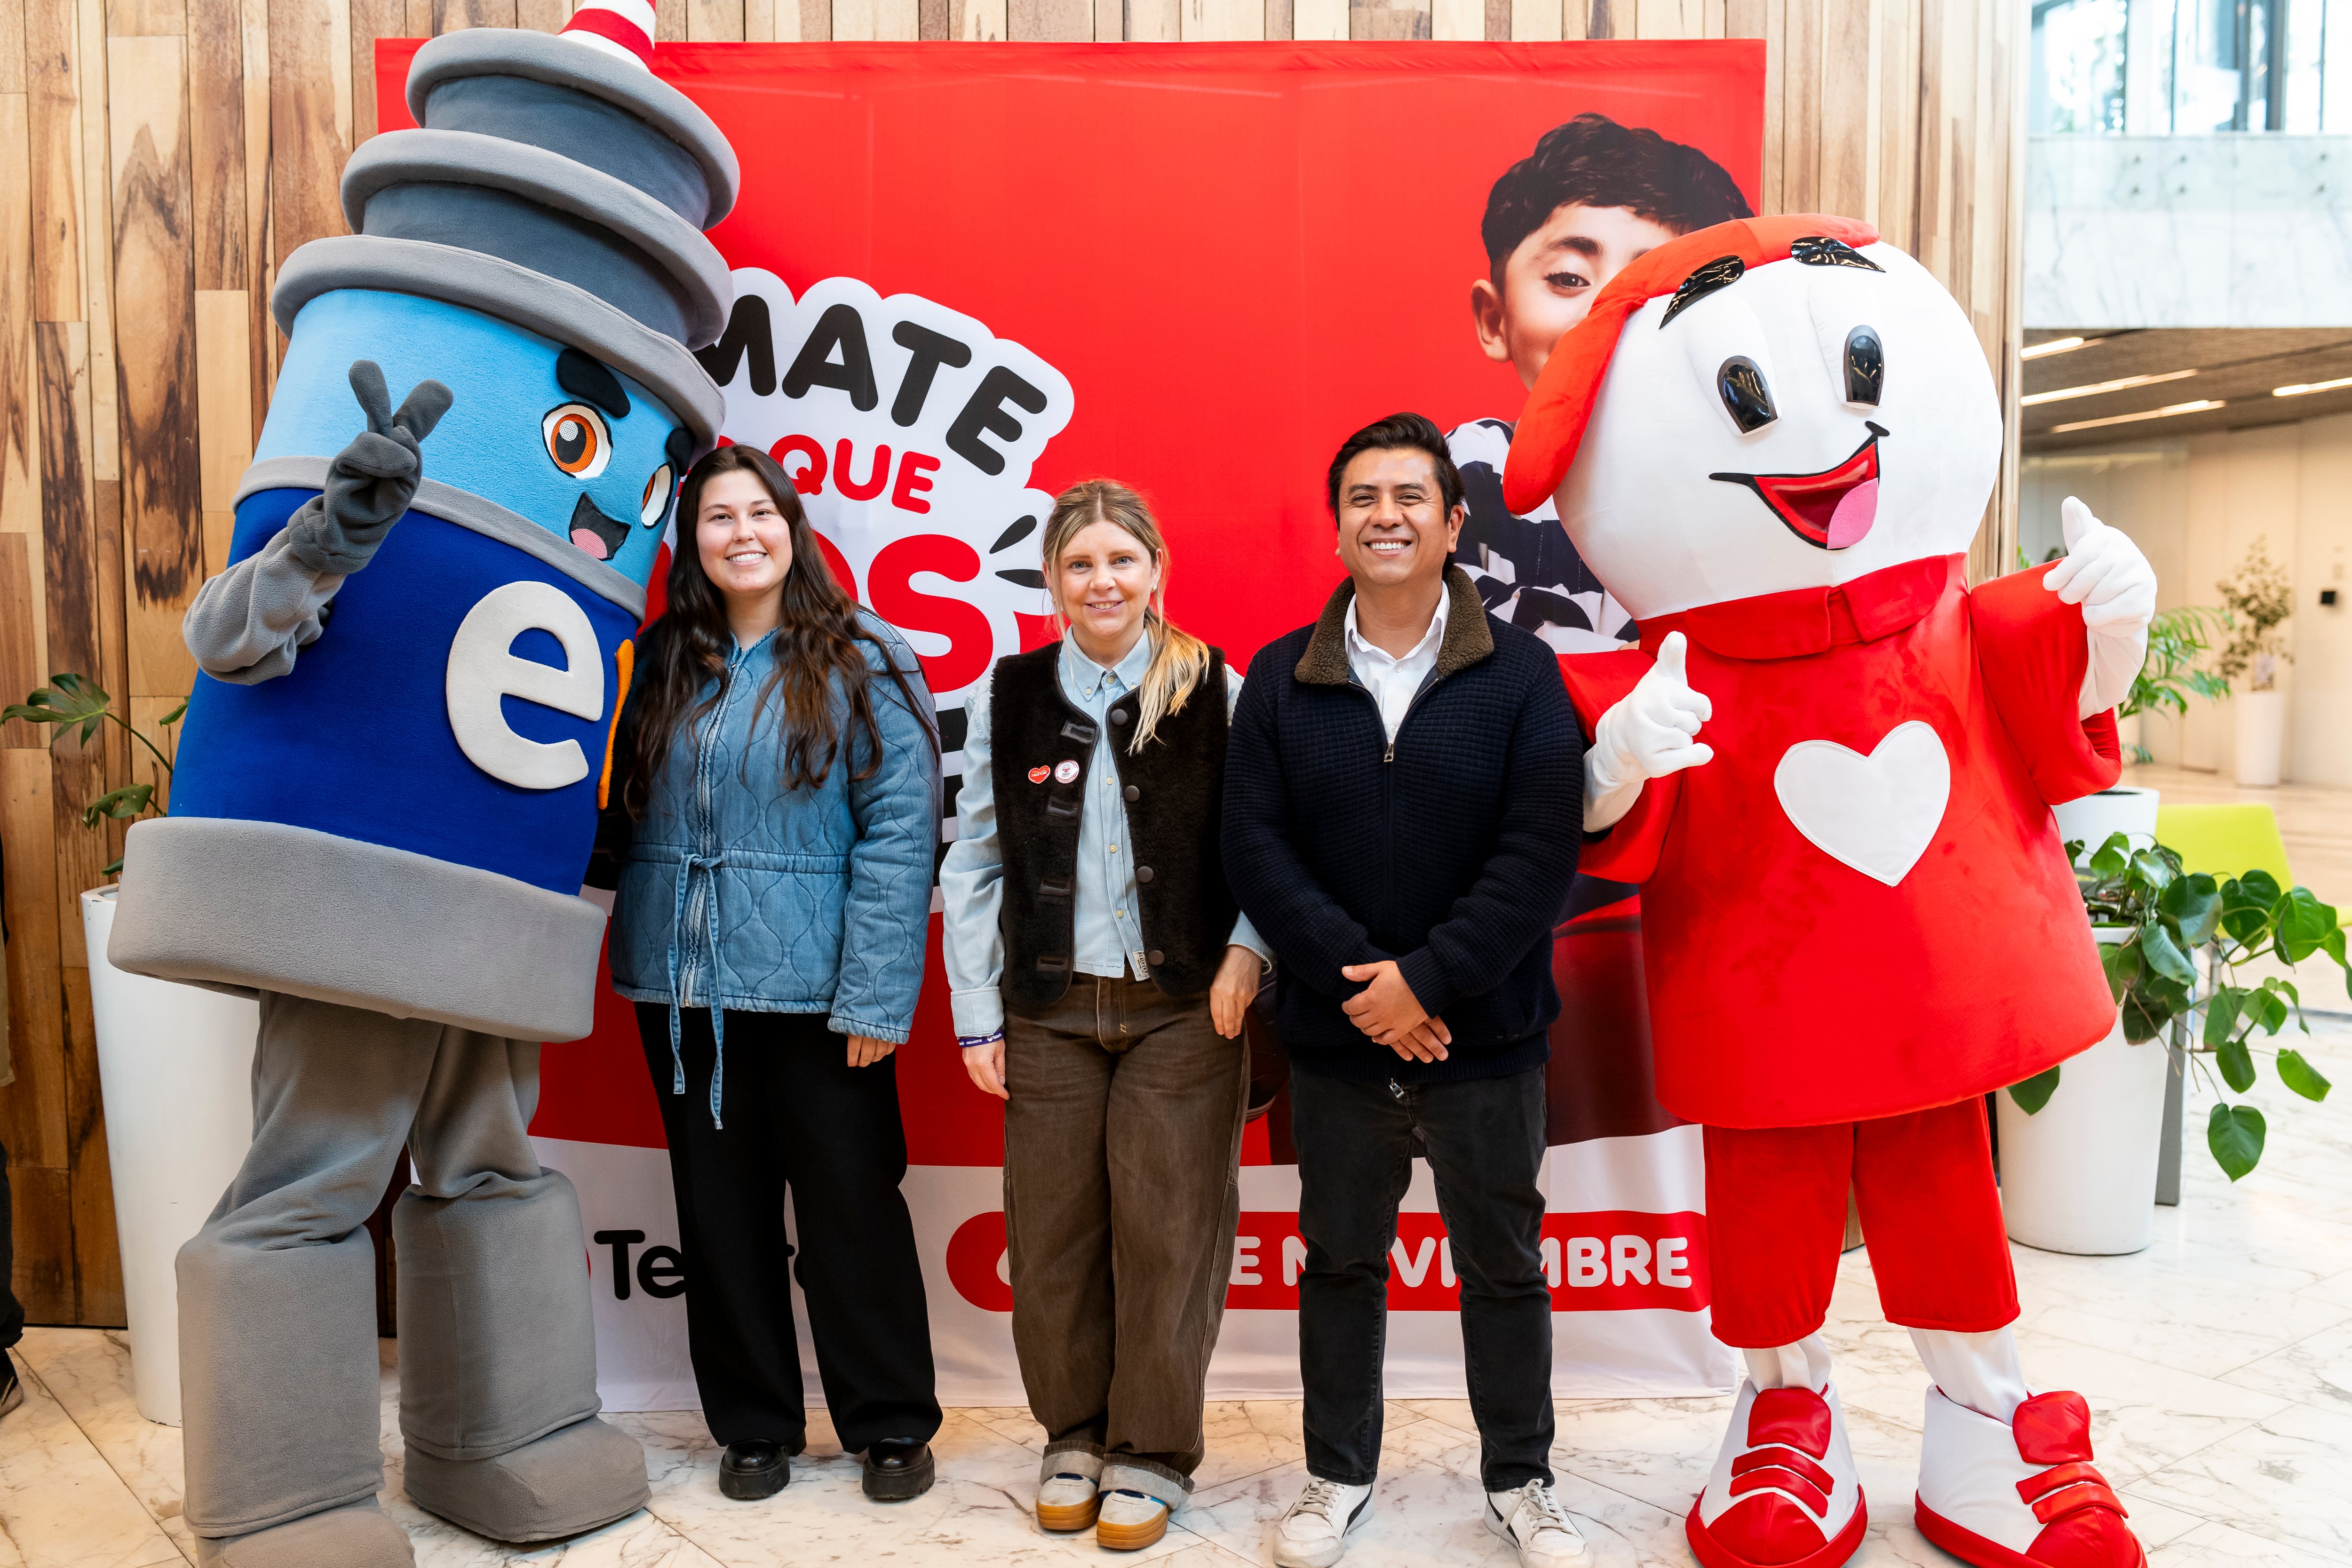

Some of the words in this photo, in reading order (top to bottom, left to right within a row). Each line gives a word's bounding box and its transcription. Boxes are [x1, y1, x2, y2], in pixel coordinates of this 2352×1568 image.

[768, 434, 941, 514] QUE
[446, 581, 604, 789] e
[1229, 1236, 1263, 1285] E
